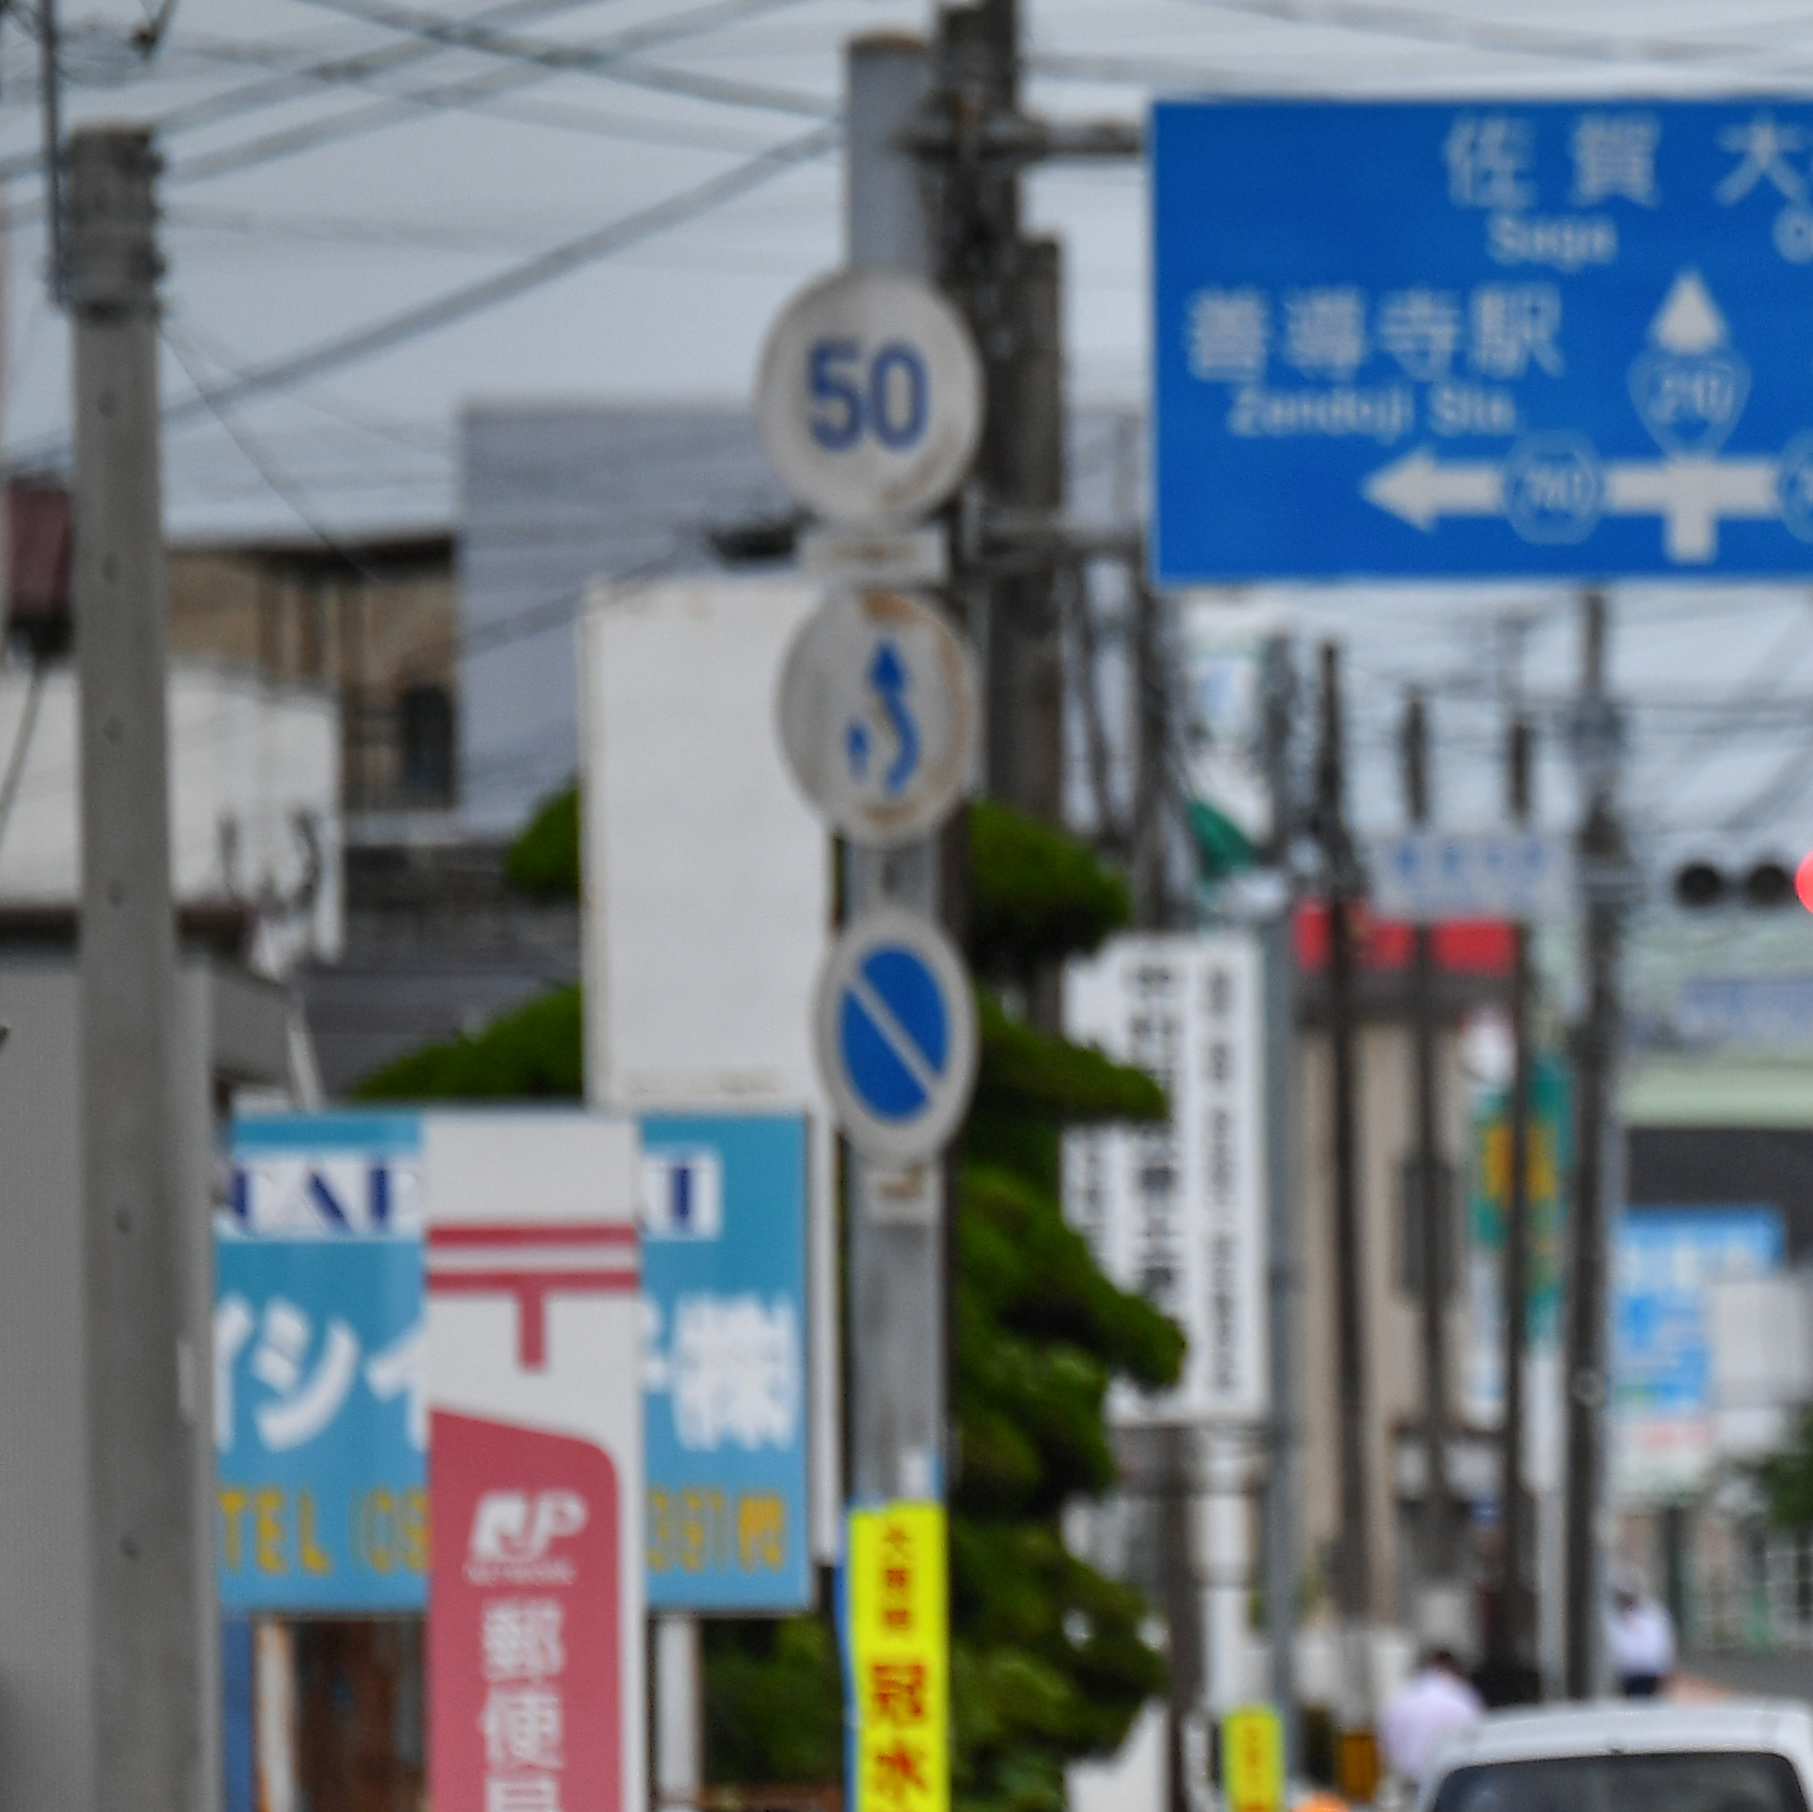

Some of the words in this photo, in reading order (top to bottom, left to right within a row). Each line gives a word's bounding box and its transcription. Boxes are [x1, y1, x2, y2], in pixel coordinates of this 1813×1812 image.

[1445, 112, 1662, 207] 佐賀
[1188, 282, 1565, 382] 善導寺駅
[808, 340, 925, 453] 50
[218, 1488, 332, 1575] TEL
